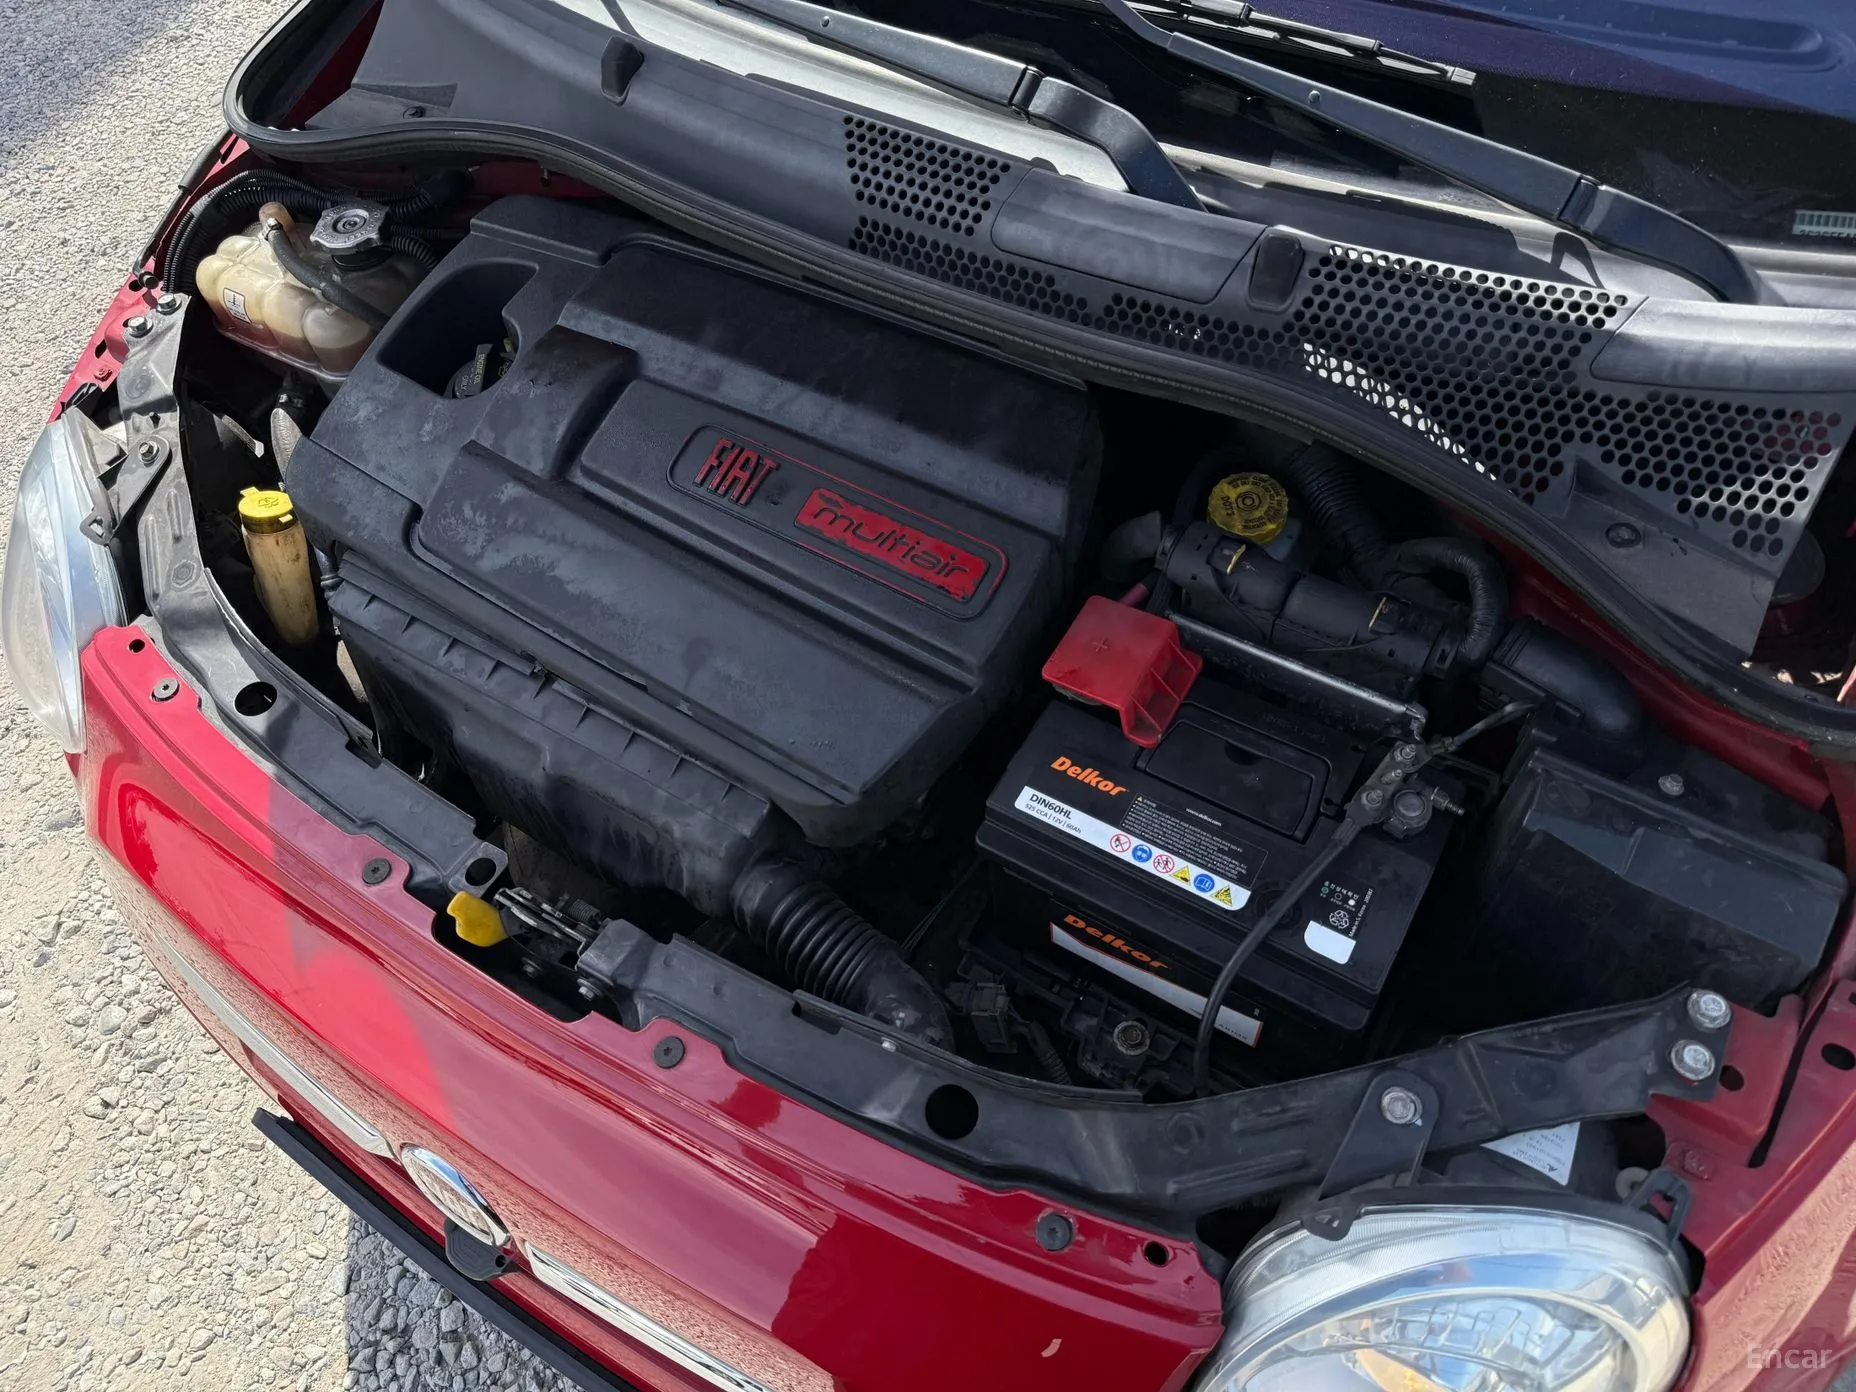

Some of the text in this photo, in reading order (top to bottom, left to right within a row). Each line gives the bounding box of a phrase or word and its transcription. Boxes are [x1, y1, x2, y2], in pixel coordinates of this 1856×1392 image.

[692, 437, 780, 506] FIAT
[813, 506, 969, 578] multiair
[1050, 756, 1128, 796] Delkor
[1025, 803, 1083, 834] 525 CCA 12V 60Ah
[1030, 793, 1073, 820] DIN60HL
[1063, 914, 1168, 968] Delkor
